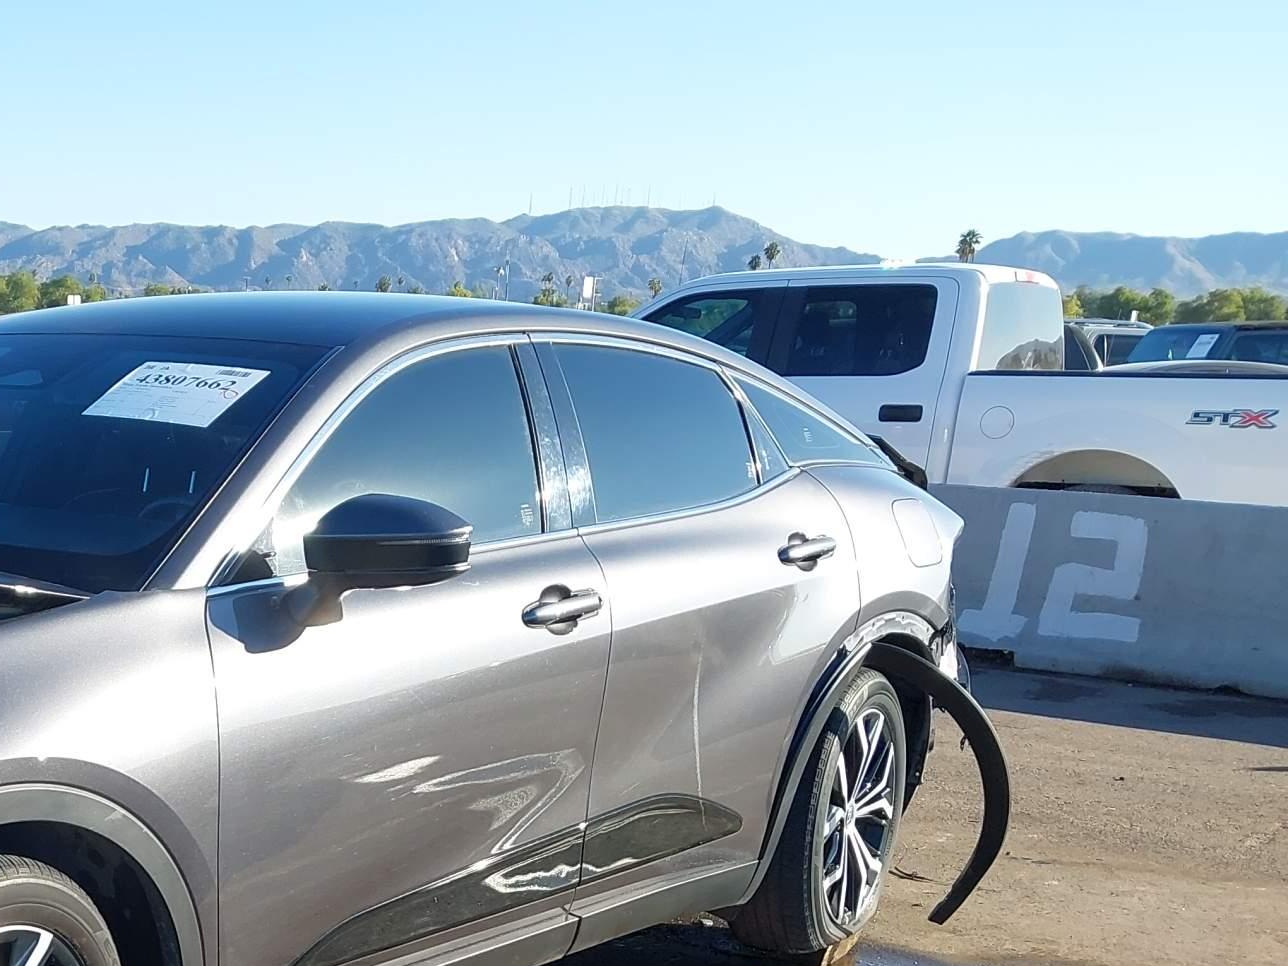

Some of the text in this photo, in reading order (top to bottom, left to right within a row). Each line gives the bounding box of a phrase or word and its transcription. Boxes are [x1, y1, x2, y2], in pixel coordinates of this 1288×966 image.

[136, 374, 237, 391] 43807662
[1185, 408, 1280, 429] STX
[956, 502, 1148, 642] 12
